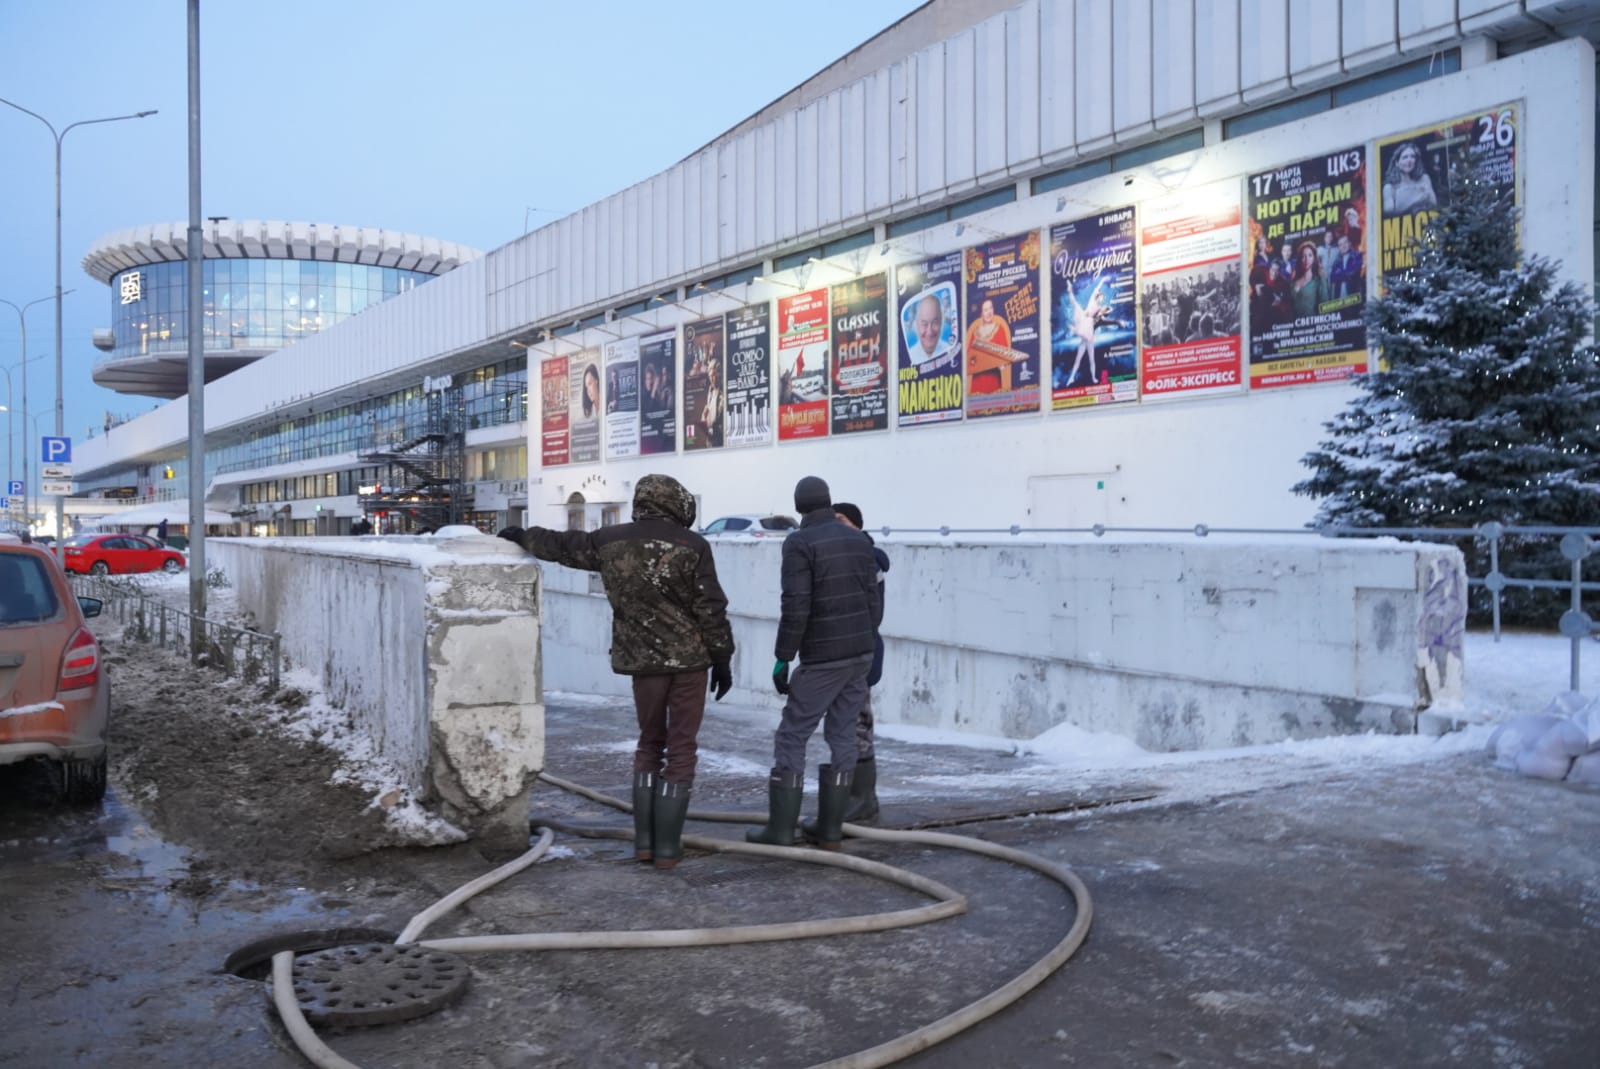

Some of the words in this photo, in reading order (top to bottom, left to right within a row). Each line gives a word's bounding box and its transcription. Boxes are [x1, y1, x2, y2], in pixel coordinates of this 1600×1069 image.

[1479, 110, 1513, 146] 26
[1327, 151, 1360, 177] ЦКЗ
[1252, 174, 1273, 197] 17
[1275, 166, 1301, 181] МАРТА
[1281, 177, 1301, 190] 19:00
[1257, 195, 1302, 220] НОТР
[1308, 182, 1351, 211] ДАМ
[1104, 210, 1132, 224] ЯНВАРЯ
[1290, 206, 1338, 232] ПАРИ
[1054, 249, 1133, 282] Щелкунчик
[837, 310, 879, 332] CLASSIC
[1295, 312, 1341, 327] СВЕТИКОВА
[1262, 330, 1290, 340] МАРКИН
[732, 347, 764, 365] COMBO
[838, 333, 880, 366] ROCK
[737, 374, 759, 390] BAND
[1146, 370, 1235, 390] ФОЛК-ЭКСПРЕСС
[899, 373, 962, 414] МАМЕНКО
[48, 440, 66, 461] P
[582, 474, 606, 489] КАССА
